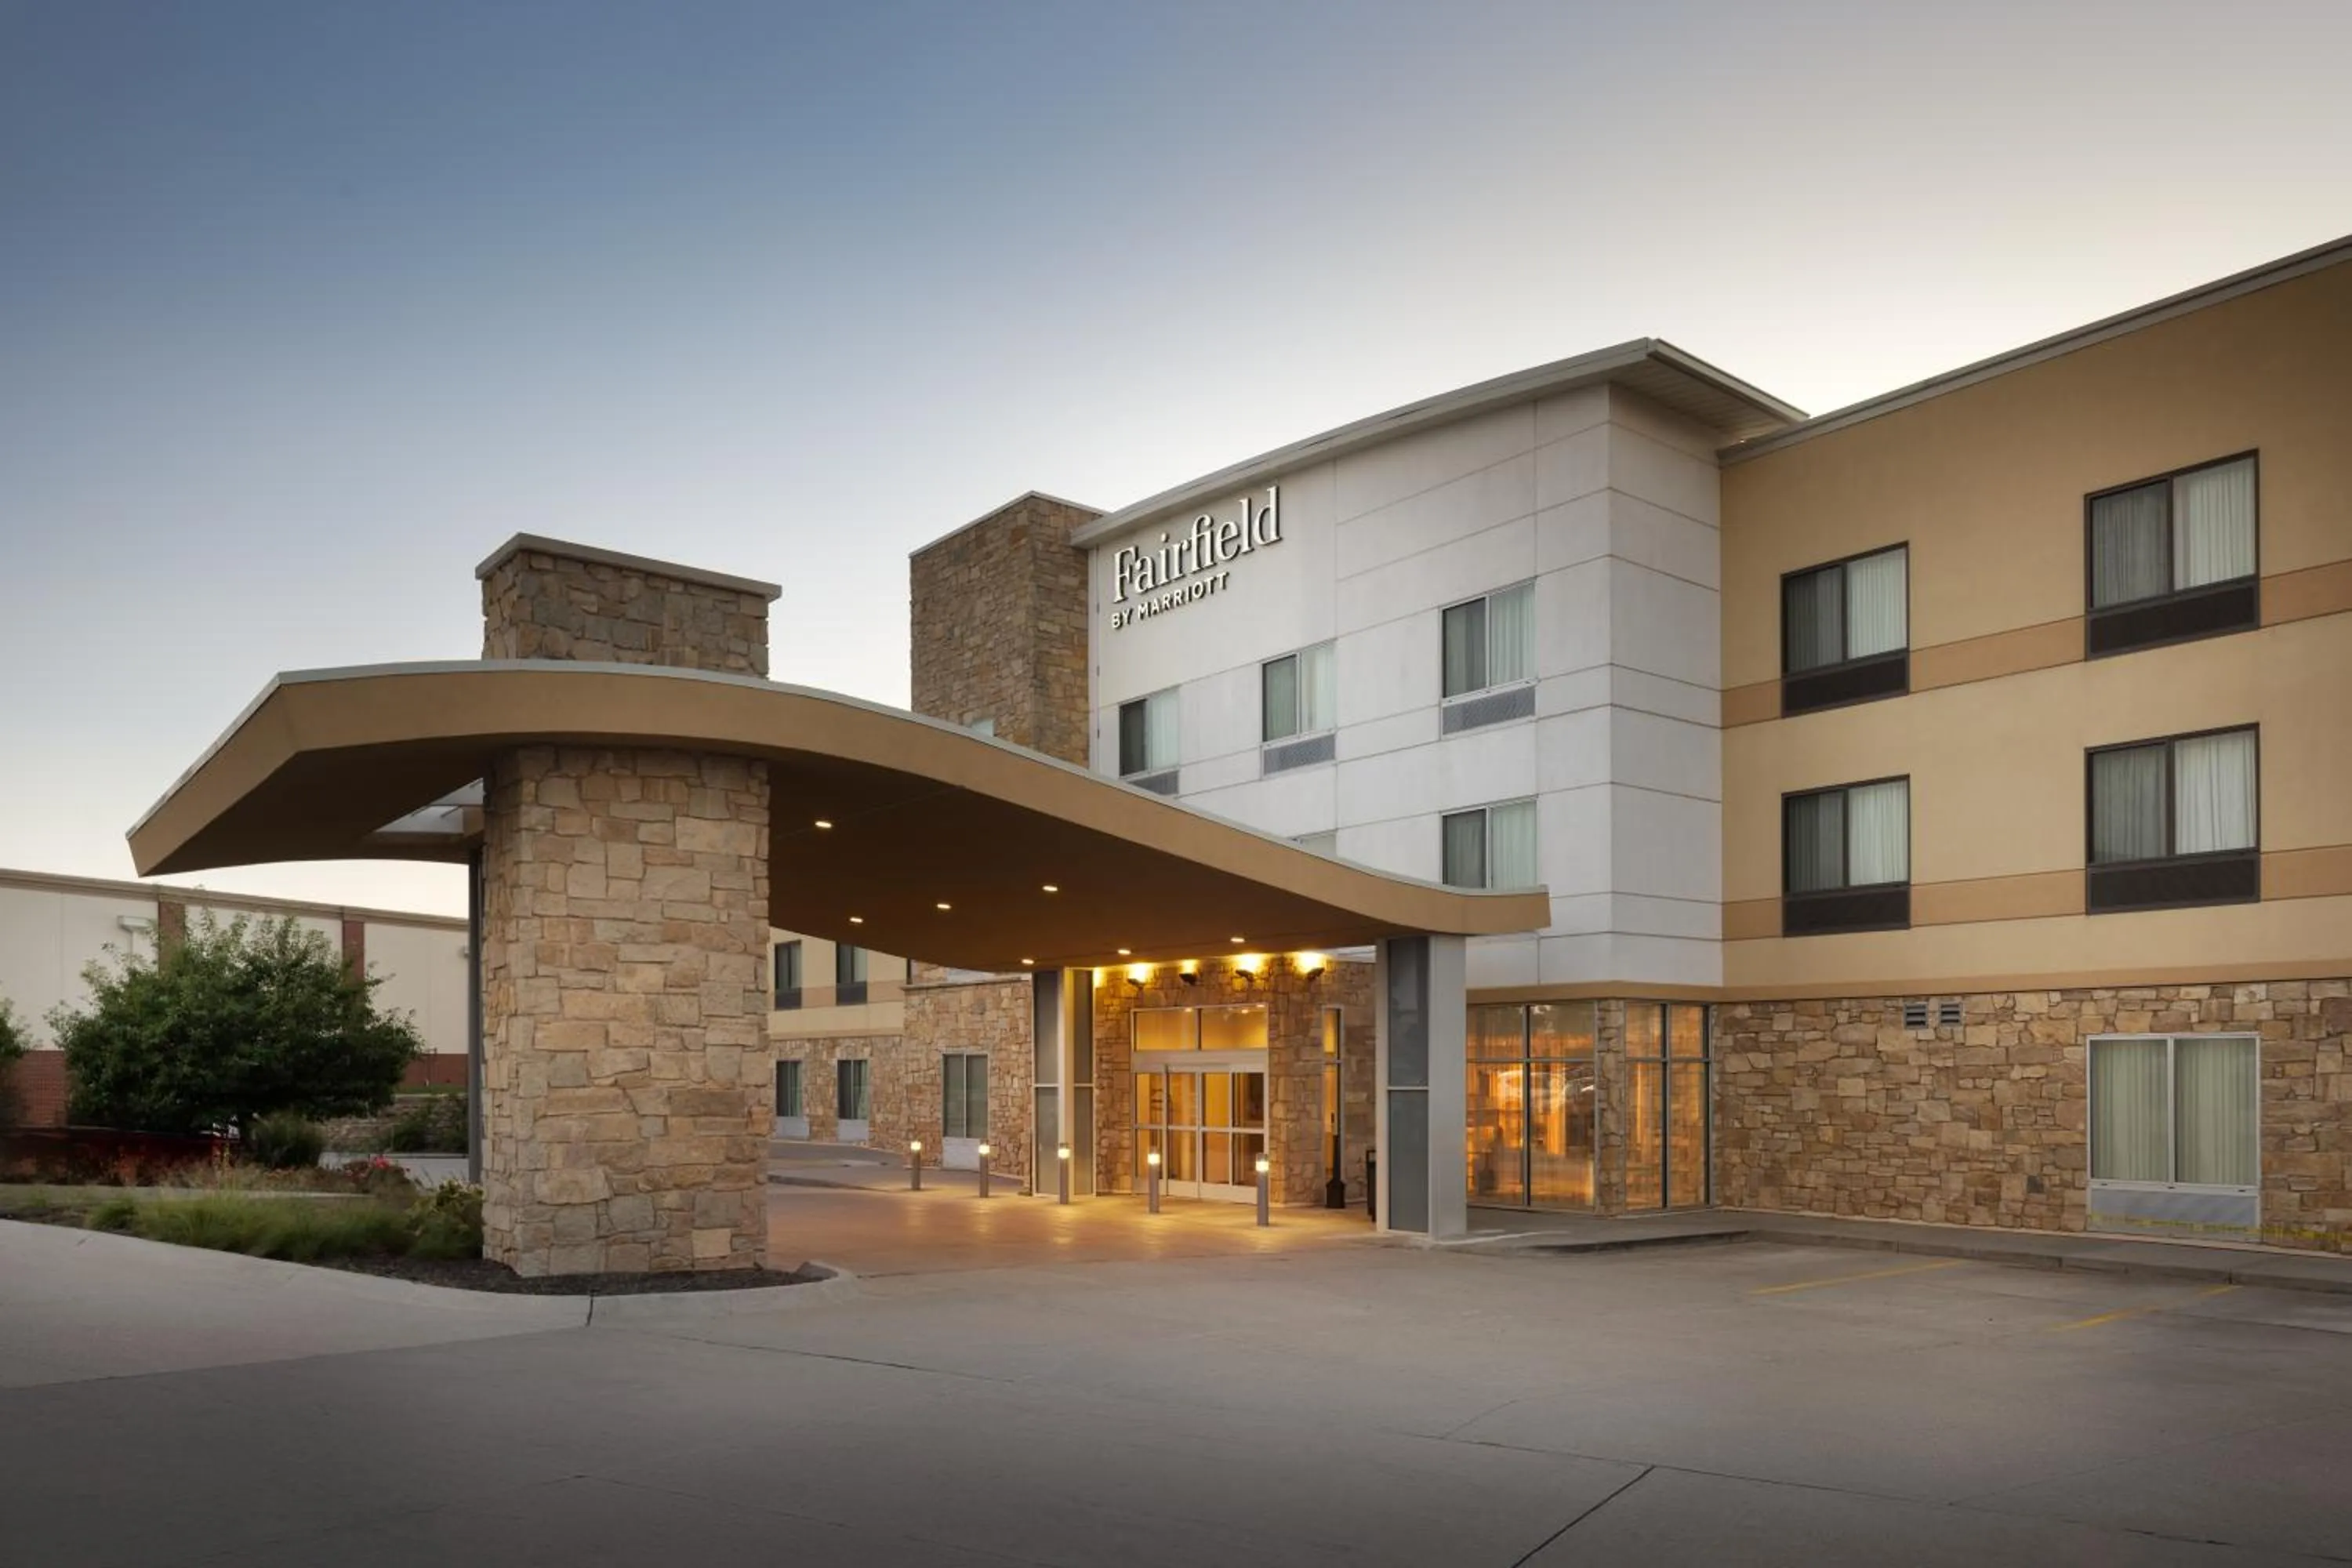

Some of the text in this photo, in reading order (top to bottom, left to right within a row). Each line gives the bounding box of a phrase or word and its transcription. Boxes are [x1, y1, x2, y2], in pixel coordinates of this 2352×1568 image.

[1113, 485, 1282, 603] Fairfield
[1111, 572, 1229, 630] BY MARRIOTT
